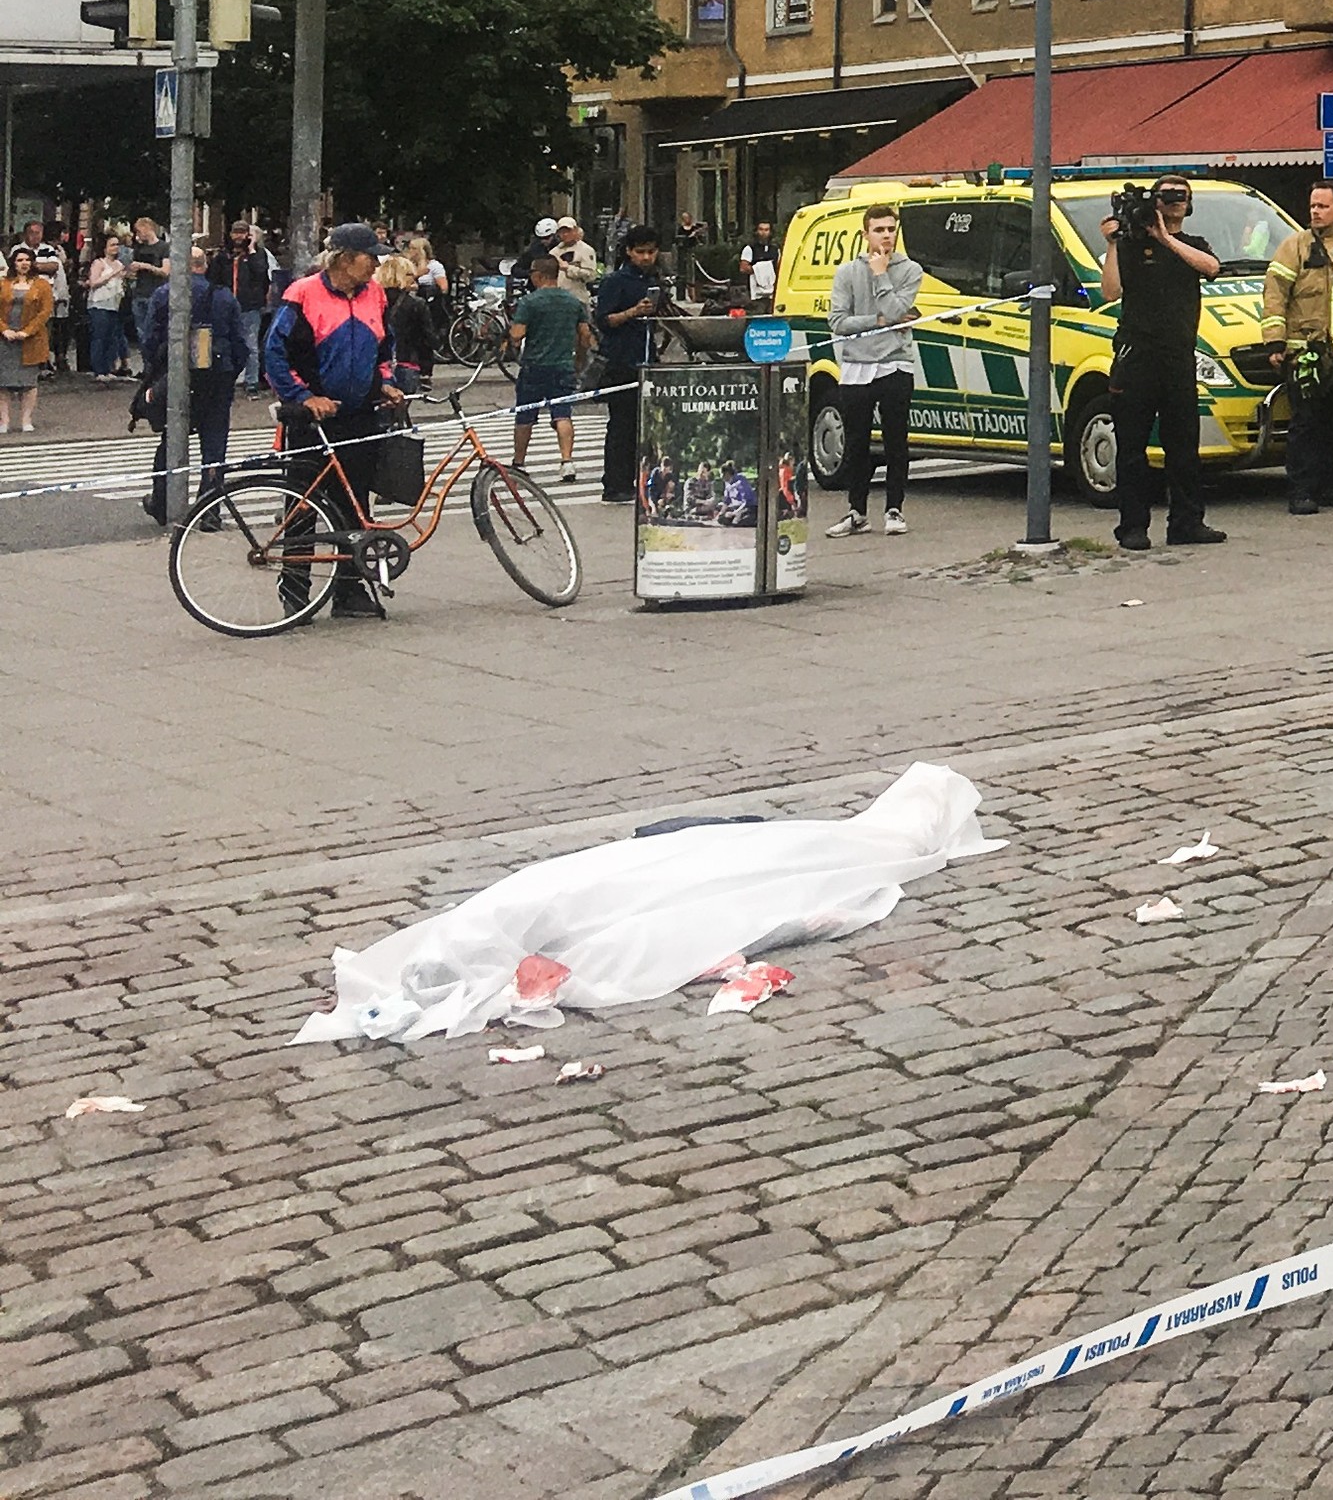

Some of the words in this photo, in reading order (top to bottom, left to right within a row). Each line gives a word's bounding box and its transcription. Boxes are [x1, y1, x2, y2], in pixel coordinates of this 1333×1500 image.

[811, 229, 848, 266] EVS
[849, 229, 865, 261] 0
[813, 295, 832, 313] FÄLT
[1203, 300, 1264, 328] EV
[656, 383, 759, 398] PARTIOAITTA
[909, 408, 942, 430] IDON
[943, 408, 1026, 435] KENTTÄJOHT
[1281, 1263, 1318, 1290] POLIS
[1165, 1289, 1242, 1332] AVSPÄRRAT
[1084, 1331, 1130, 1362] POLIISI
